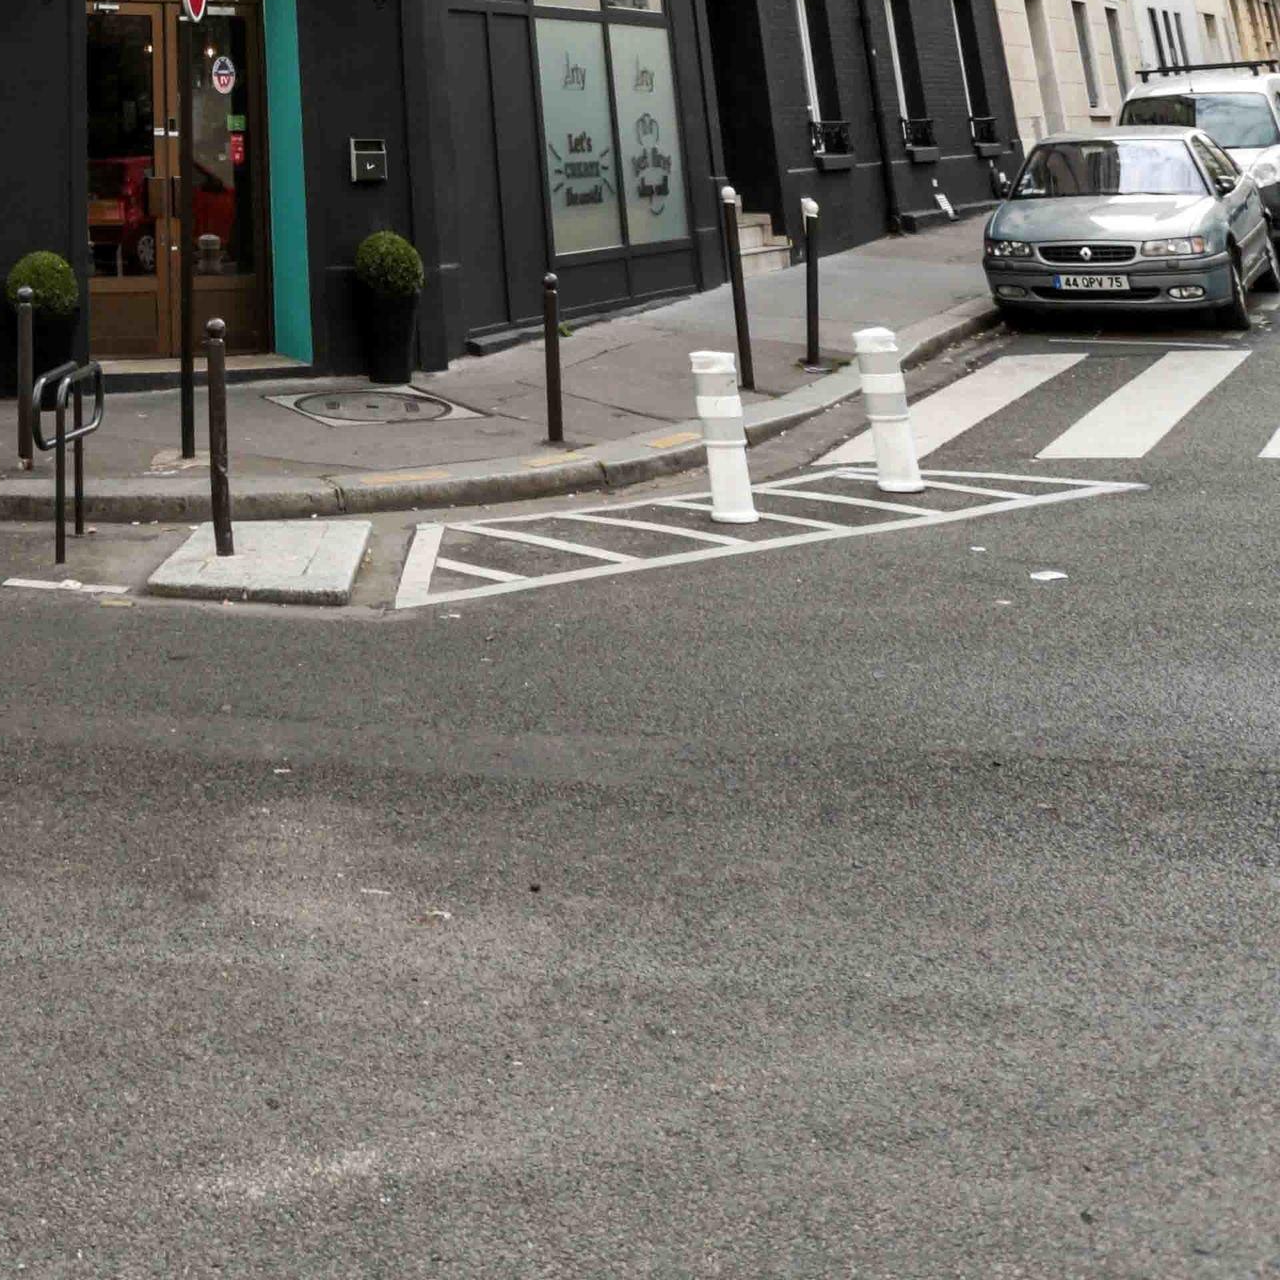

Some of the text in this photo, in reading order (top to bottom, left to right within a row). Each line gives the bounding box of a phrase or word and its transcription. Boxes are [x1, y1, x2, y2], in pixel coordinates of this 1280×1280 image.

[1065, 277, 1122, 288] 44 QPV 75
